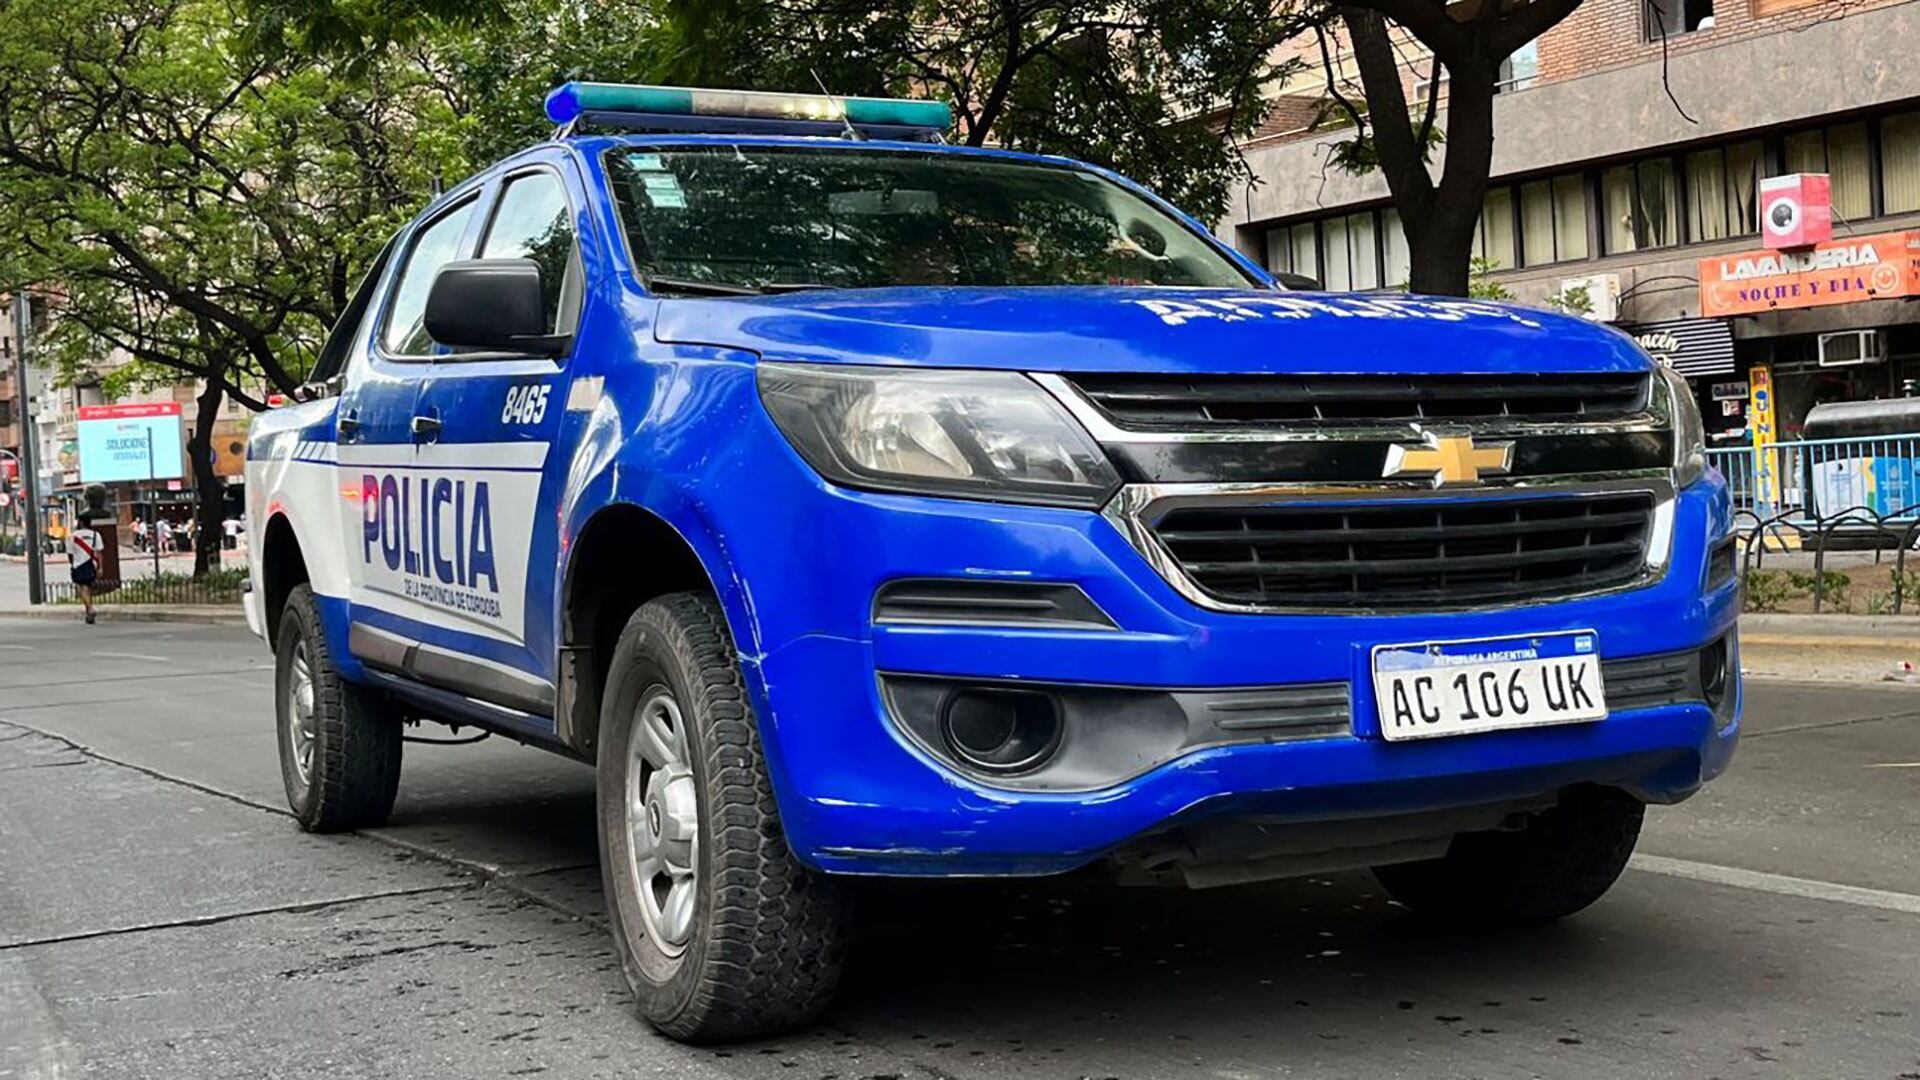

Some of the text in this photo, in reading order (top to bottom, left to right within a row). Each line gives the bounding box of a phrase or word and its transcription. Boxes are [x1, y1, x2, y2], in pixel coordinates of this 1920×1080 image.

[1720, 243, 1880, 281] LAVANDERIA
[1739, 277, 1865, 302] NOCHE Y DIA
[501, 384, 551, 424] 8465
[106, 437, 150, 450] SOLUCIONE
[363, 474, 499, 593] POLICIA
[404, 579, 412, 594] DE
[412, 581, 420, 598] LA
[420, 583, 455, 606] PROVINCIA
[455, 592, 466, 610] DE
[1486, 648, 1538, 662] ARGENTINA
[1393, 662, 1594, 727] AC 106 UK
